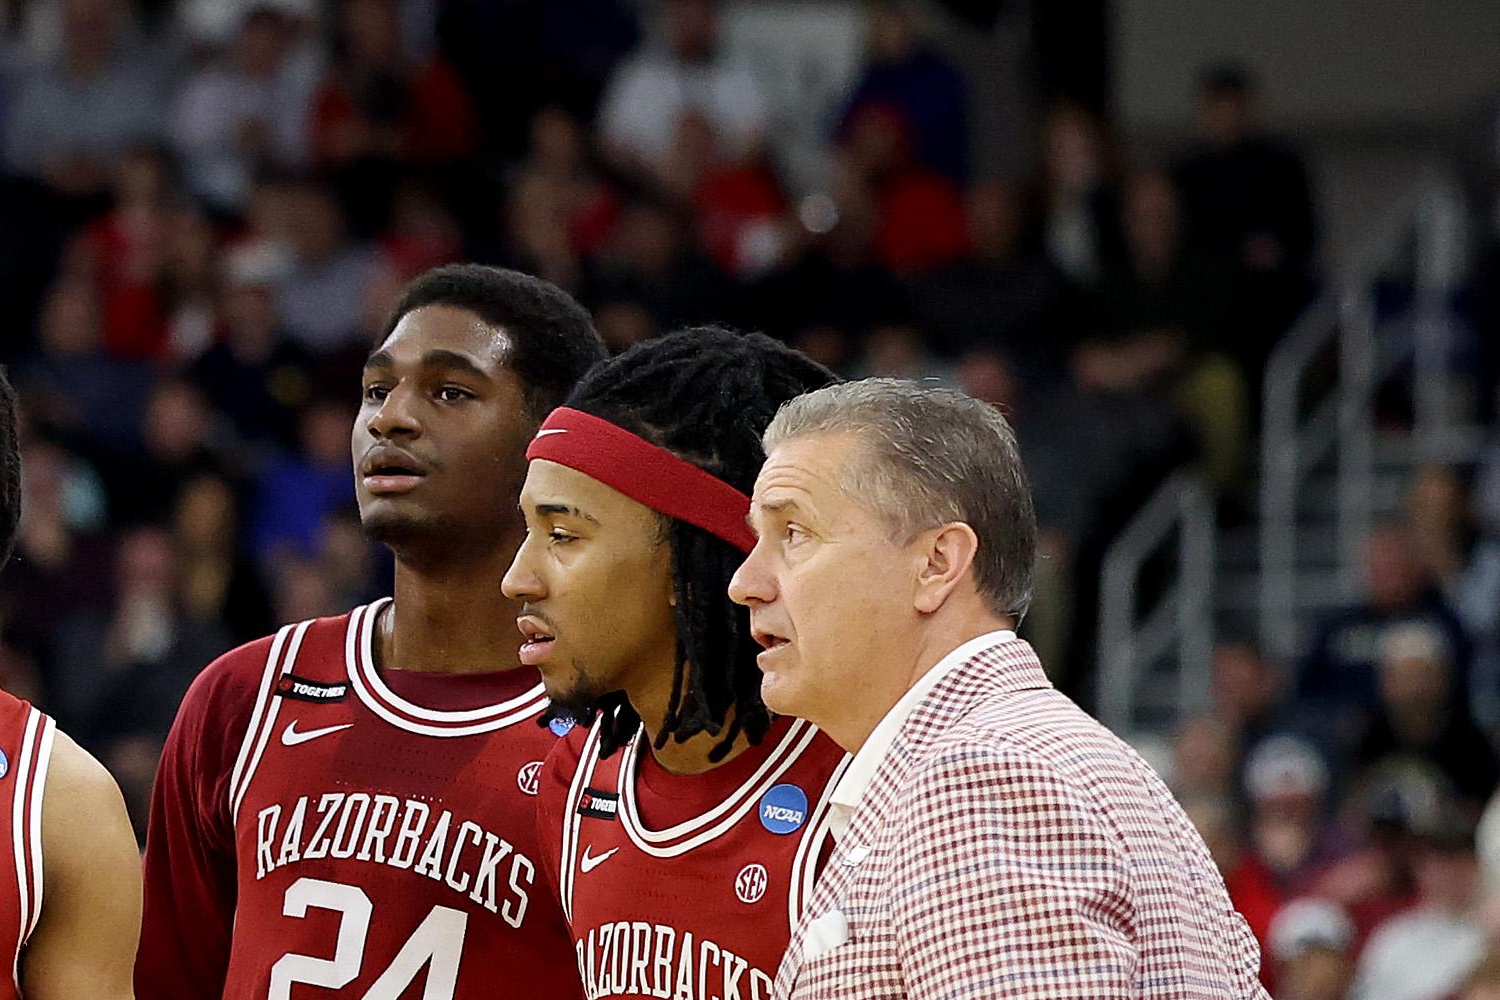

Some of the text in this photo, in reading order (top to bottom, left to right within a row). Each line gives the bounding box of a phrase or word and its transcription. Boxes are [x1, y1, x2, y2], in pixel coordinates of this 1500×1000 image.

[293, 683, 346, 697] TOGETHER
[764, 805, 803, 824] NCAA
[256, 793, 535, 928] RAZORBACKS
[738, 866, 765, 900] SEC
